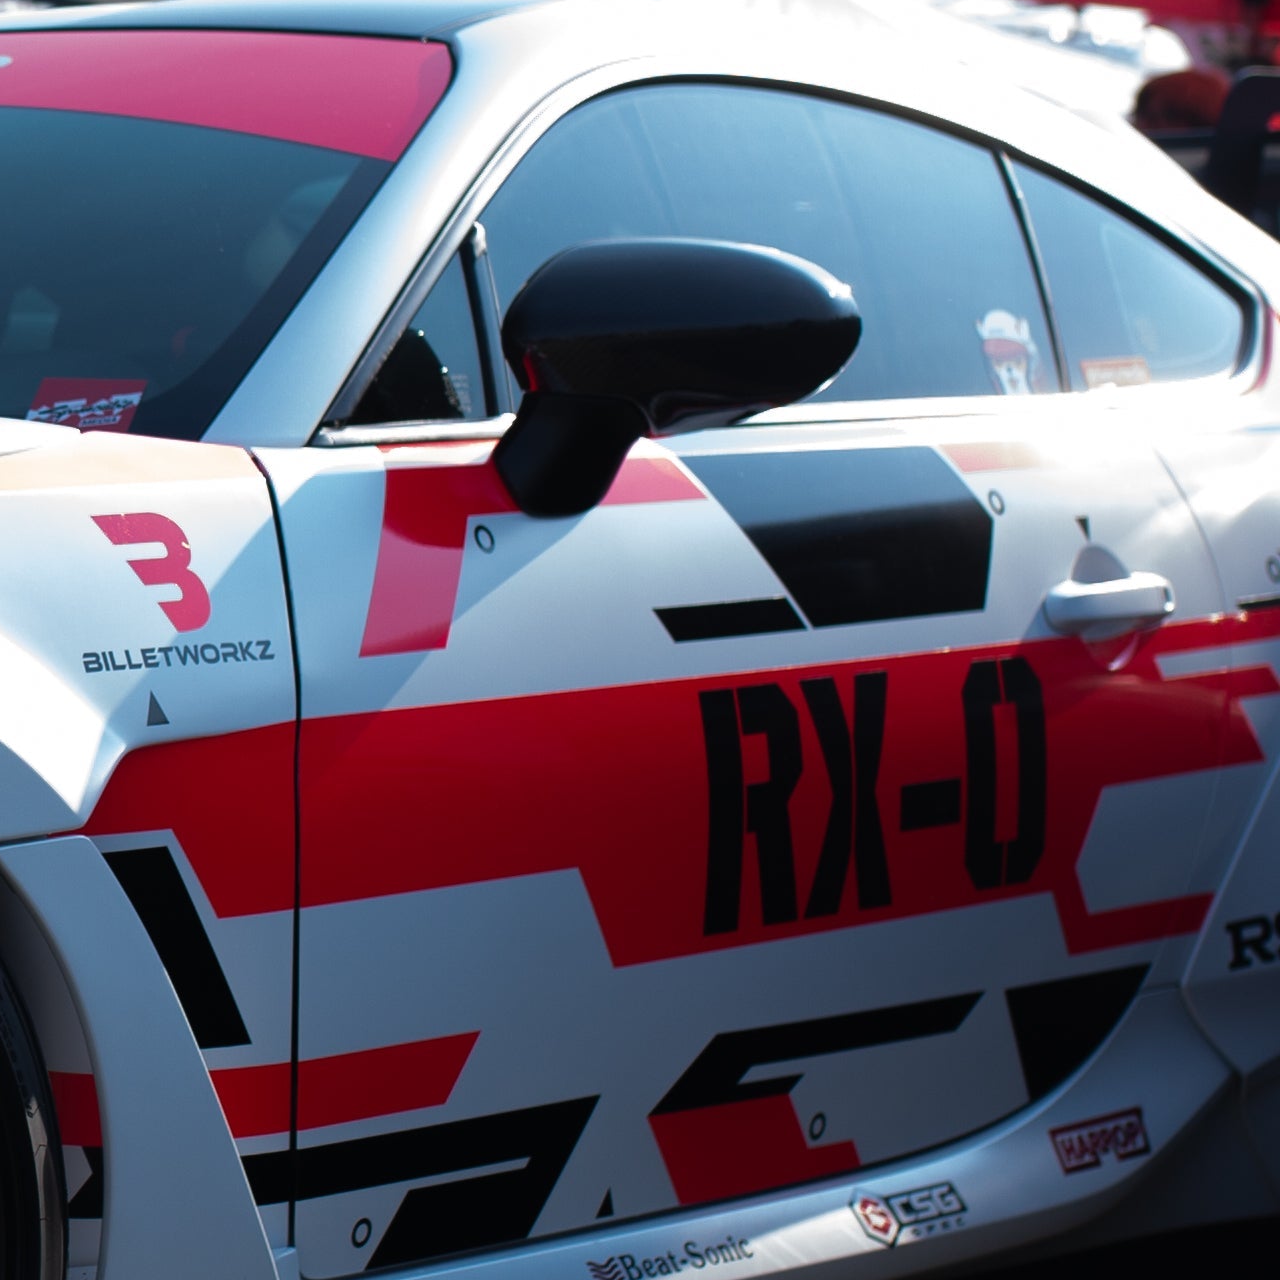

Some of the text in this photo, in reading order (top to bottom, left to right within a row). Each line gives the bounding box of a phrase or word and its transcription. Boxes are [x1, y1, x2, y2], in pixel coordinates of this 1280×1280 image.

[82, 639, 275, 674] BILLETWORKZ
[1226, 911, 1280, 972] R
[886, 1183, 964, 1225] CSG
